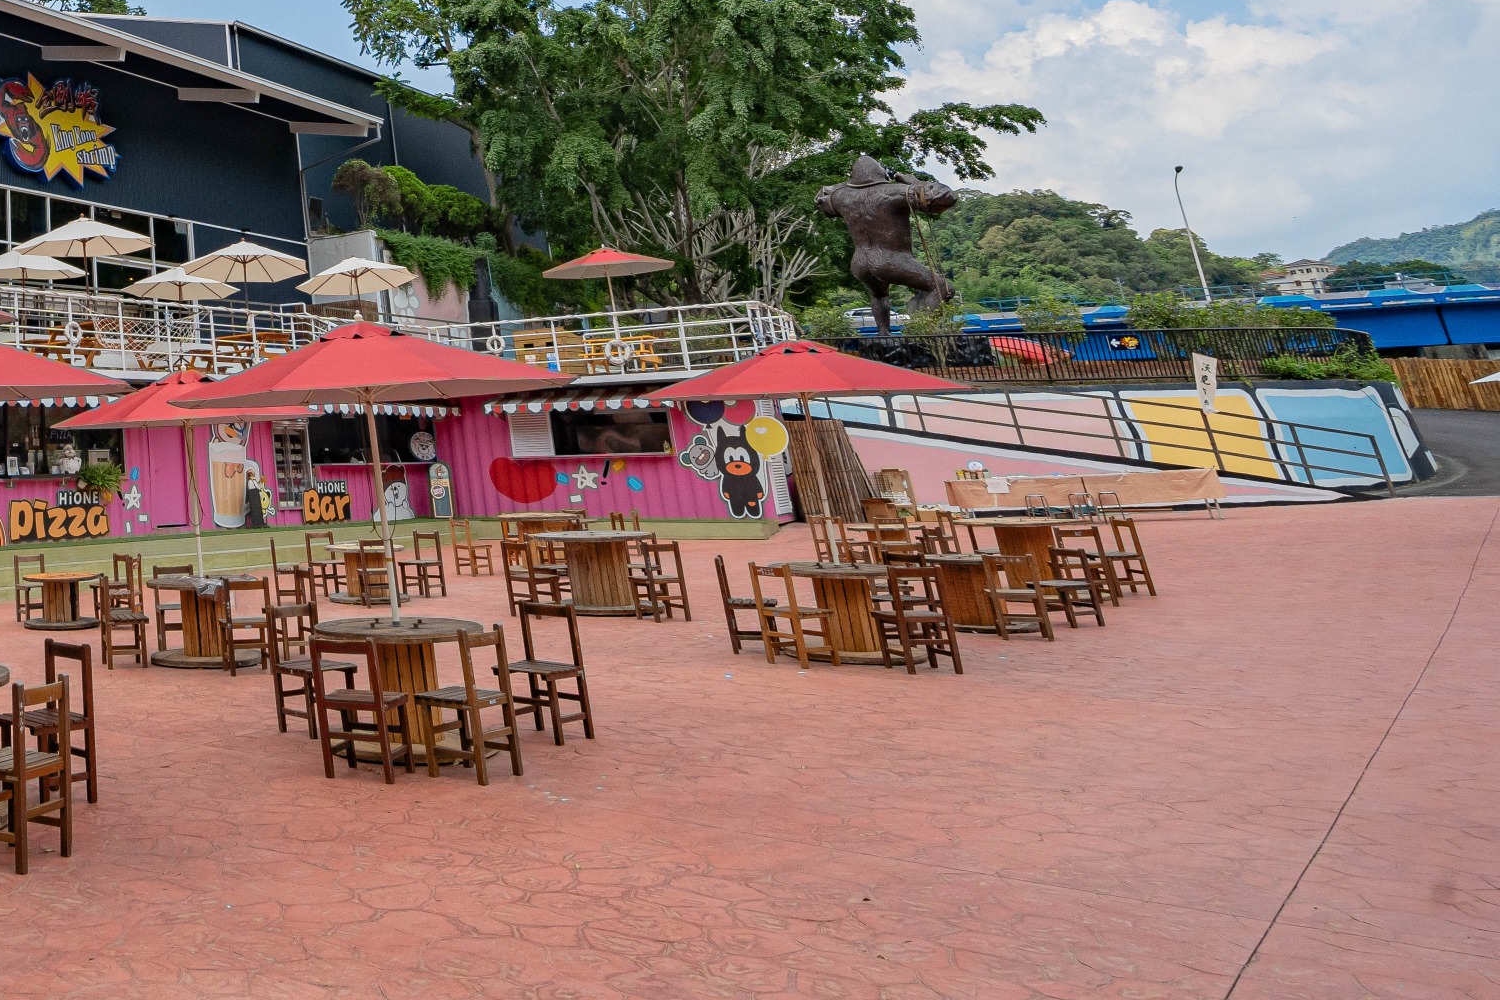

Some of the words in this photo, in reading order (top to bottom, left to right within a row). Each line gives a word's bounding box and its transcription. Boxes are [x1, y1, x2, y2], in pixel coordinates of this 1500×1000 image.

[51, 124, 75, 152] King
[74, 126, 97, 146] Kong
[76, 145, 116, 170] shrimp
[50, 429, 72, 440] PIZZA
[304, 489, 350, 522] Bar
[11, 500, 109, 541] Pizza
